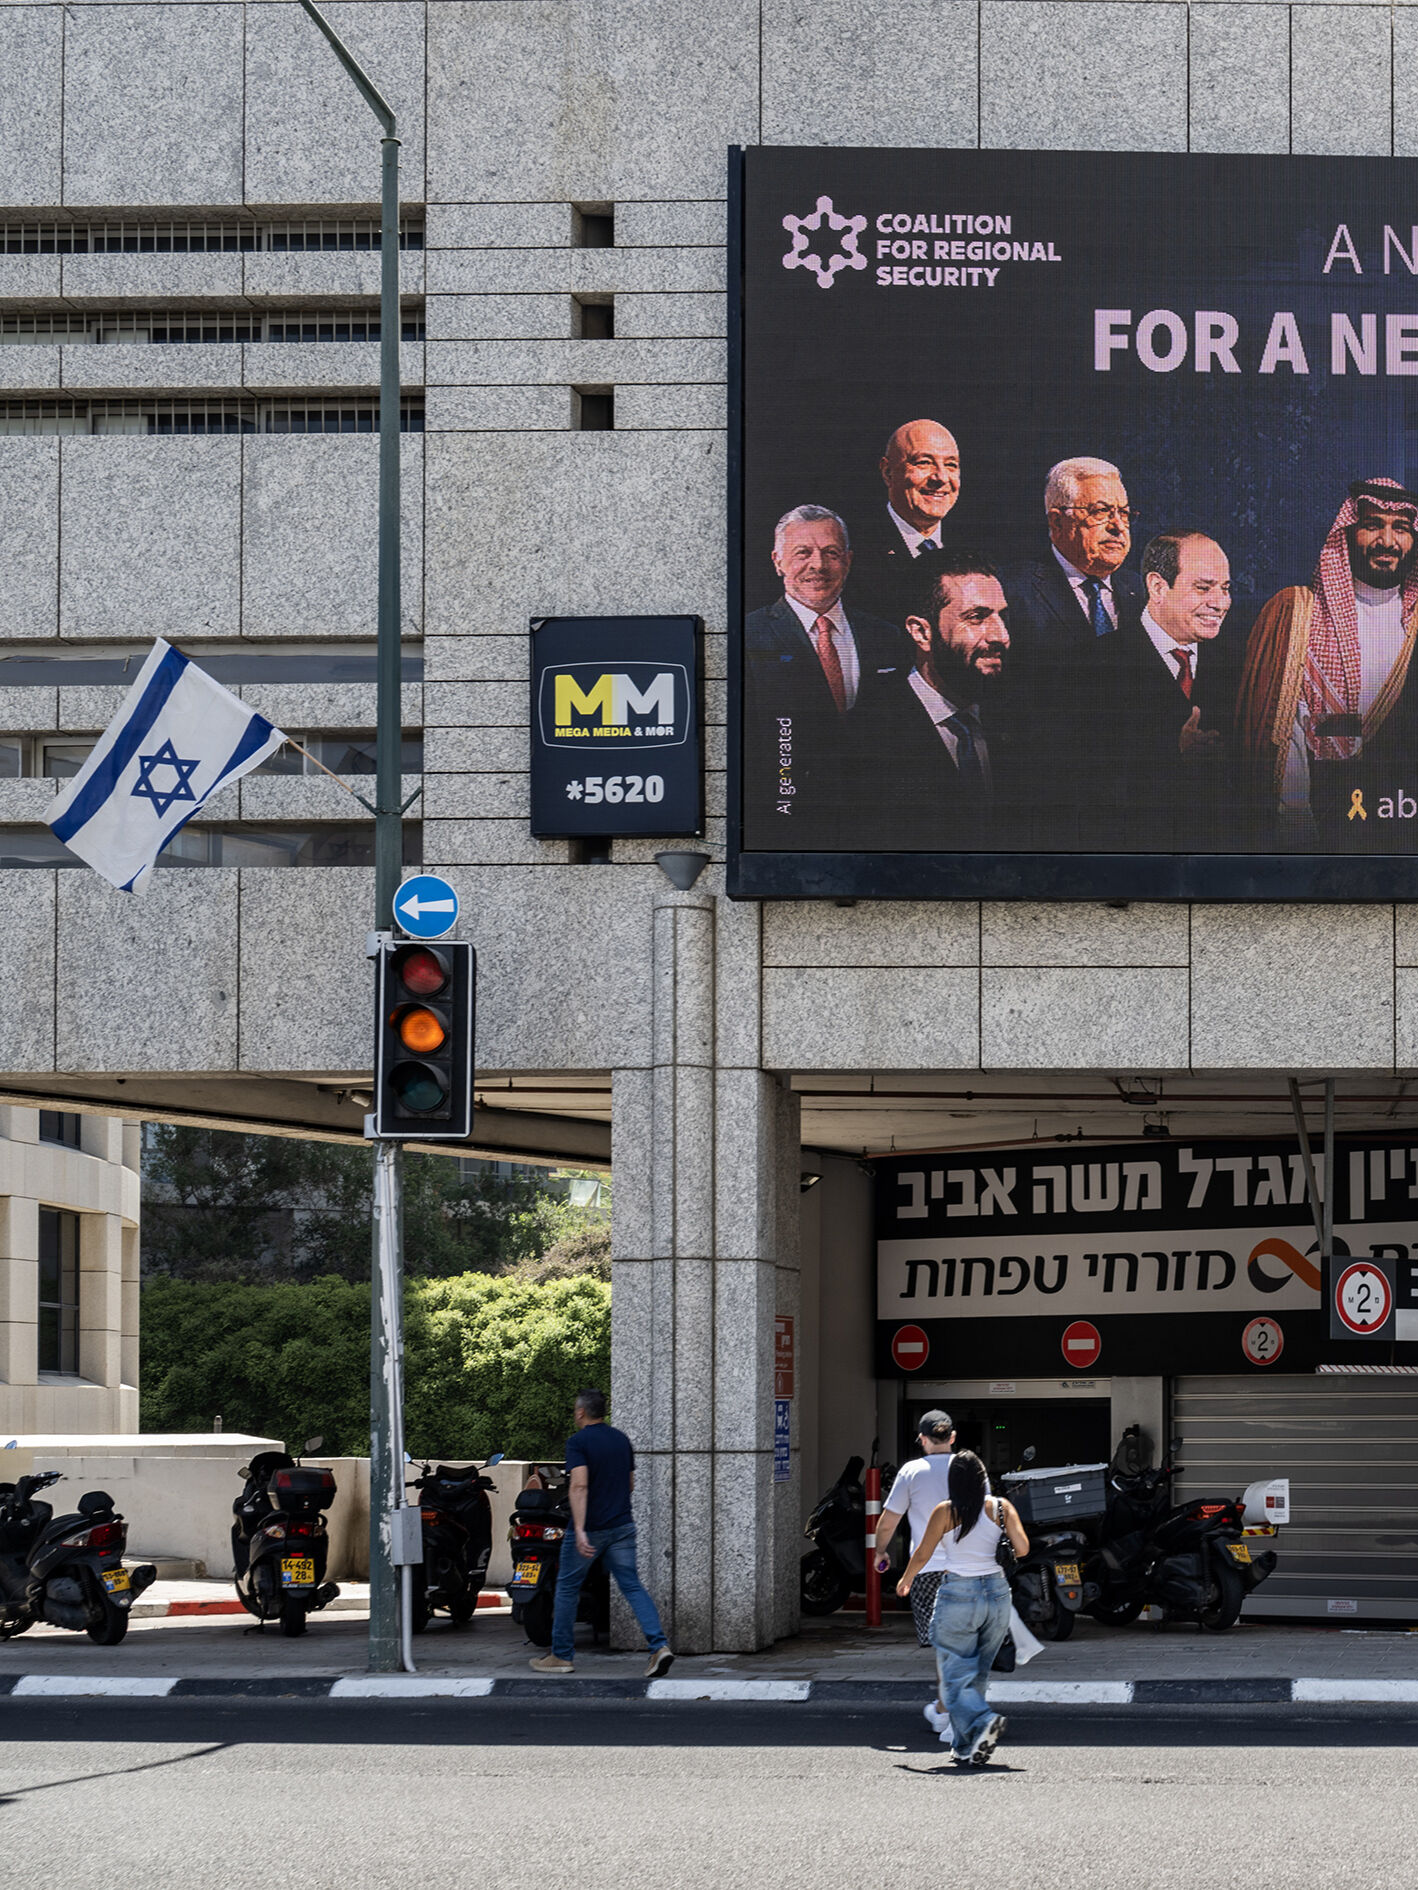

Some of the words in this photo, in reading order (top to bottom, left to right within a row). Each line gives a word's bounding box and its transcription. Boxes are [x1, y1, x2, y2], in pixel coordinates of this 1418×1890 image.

[876, 213, 1012, 236] COALITION
[876, 240, 928, 261] FOR
[933, 240, 1062, 262] REGIONAL
[1322, 224, 1363, 275] A
[876, 265, 1001, 288] SECURITY
[1094, 308, 1242, 374] FOR
[1258, 312, 1310, 374] A
[555, 673, 674, 726] MM
[555, 728, 590, 737] MEGA
[593, 728, 631, 737] MEDIA
[634, 727, 643, 736] &
[645, 727, 674, 736] MOR
[776, 717, 796, 795] generated
[776, 800, 792, 815] AI
[896, 1166, 1018, 1219] אביב
[1032, 1161, 1162, 1214] משה
[1178, 1148, 1325, 1208] מגדל
[900, 1254, 1068, 1299] טפחות
[1083, 1249, 1237, 1294] מזרחי
[1357, 1283, 1371, 1313] 2
[1257, 1331, 1268, 1351] 2
[295, 1571, 307, 1580] 28
